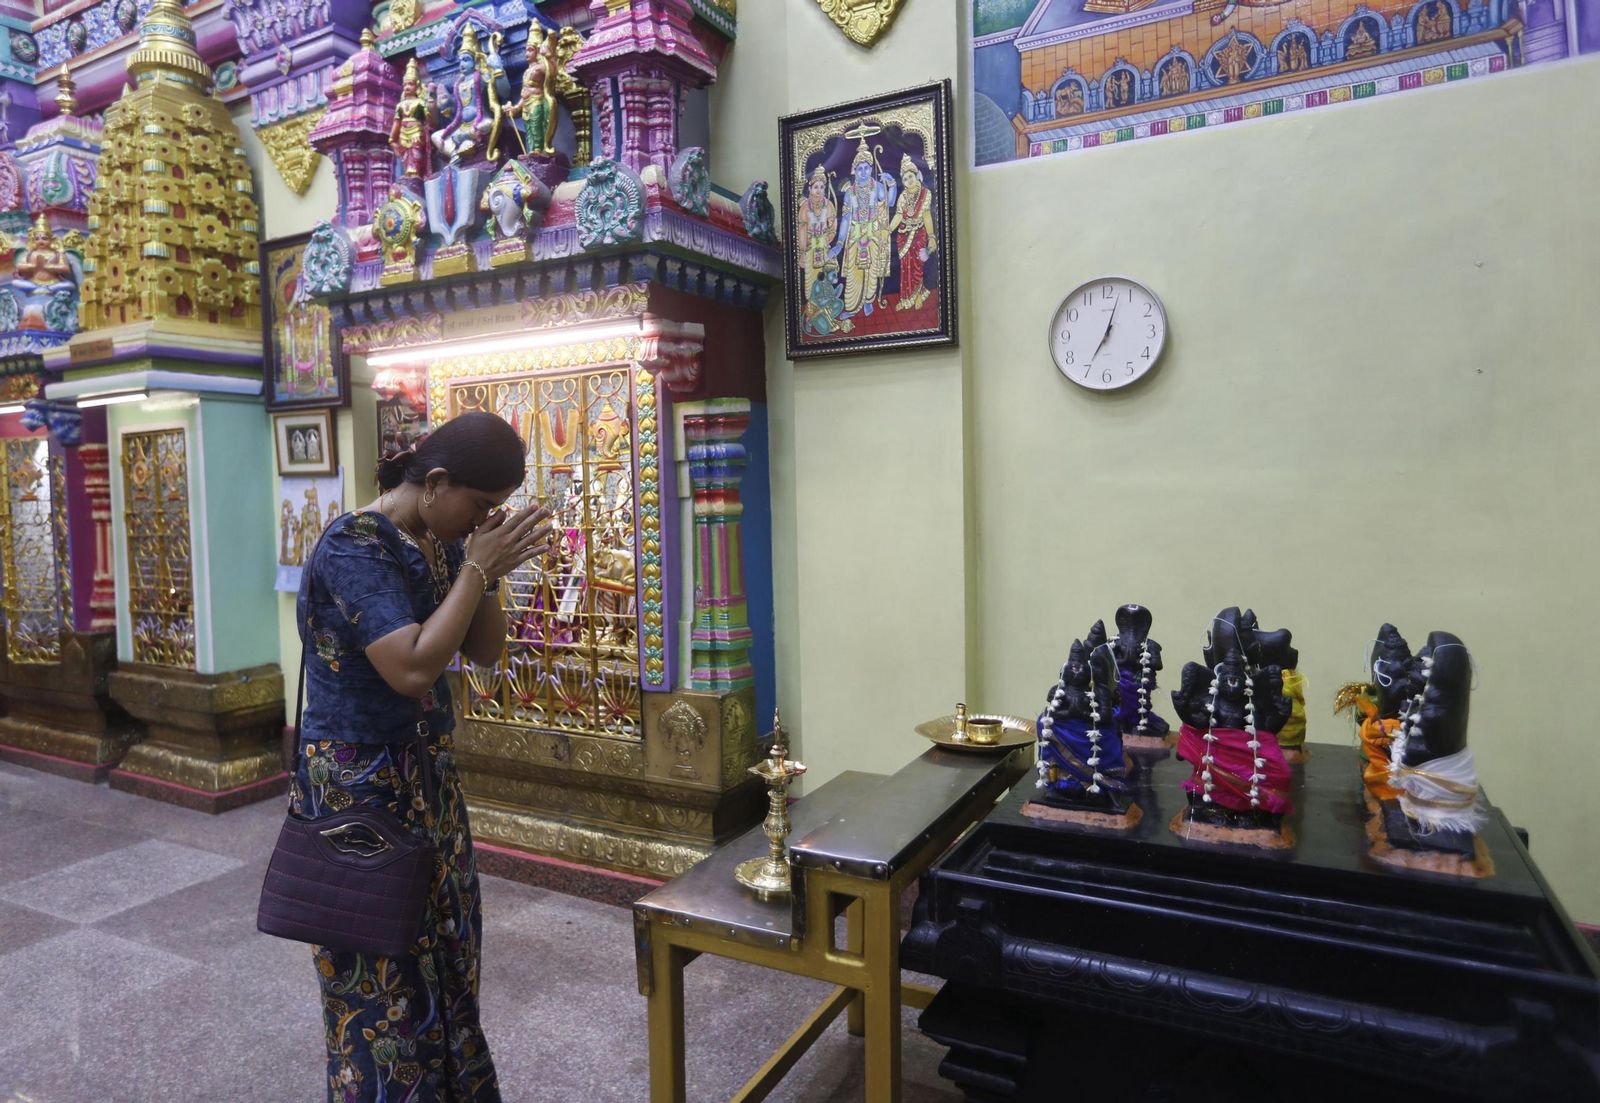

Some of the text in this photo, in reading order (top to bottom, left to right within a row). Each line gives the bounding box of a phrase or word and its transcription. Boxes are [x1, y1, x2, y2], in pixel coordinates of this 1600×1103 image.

[1083, 291, 1092, 306] 11
[1102, 285, 1114, 299] 12
[1128, 288, 1132, 303] 1
[1066, 308, 1078, 323] 10
[1143, 302, 1152, 318] 2
[1061, 330, 1071, 344] 9
[1146, 323, 1156, 339] 3
[1065, 351, 1074, 365] 8
[1140, 345, 1150, 360] 4
[1083, 364, 1092, 378] 7
[1102, 368, 1112, 383] 6
[1125, 361, 1134, 376] 5
